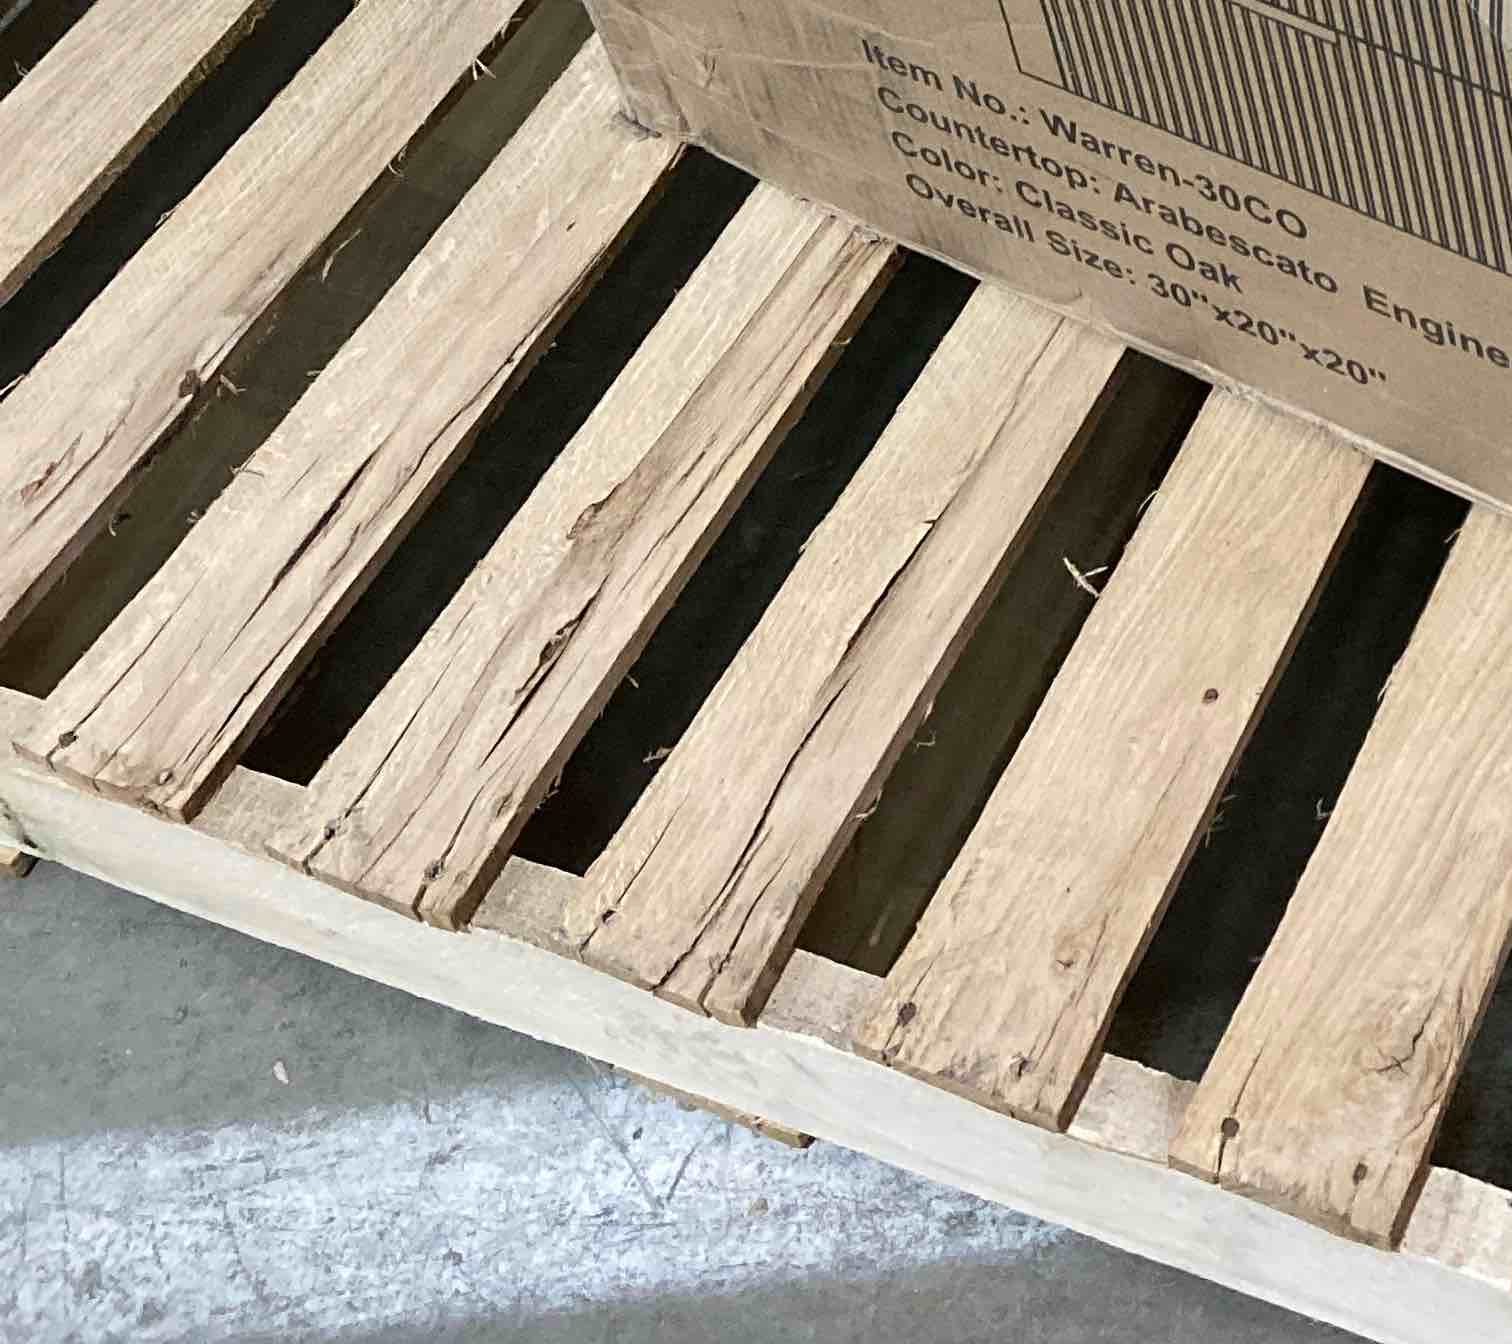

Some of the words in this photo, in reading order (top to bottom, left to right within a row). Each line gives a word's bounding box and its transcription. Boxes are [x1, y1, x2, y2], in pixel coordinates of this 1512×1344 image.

[861, 39, 943, 92] Item
[952, 75, 1030, 126] No.:
[1040, 109, 1309, 240] Warren-30CO
[876, 86, 1102, 194] Countertop:
[1114, 183, 1338, 294] Arabescato
[893, 130, 1004, 194] Color:
[1016, 180, 1155, 256] Classic
[1166, 242, 1244, 295] Oak
[906, 173, 1034, 244] Overall
[1046, 229, 1135, 285] Size:
